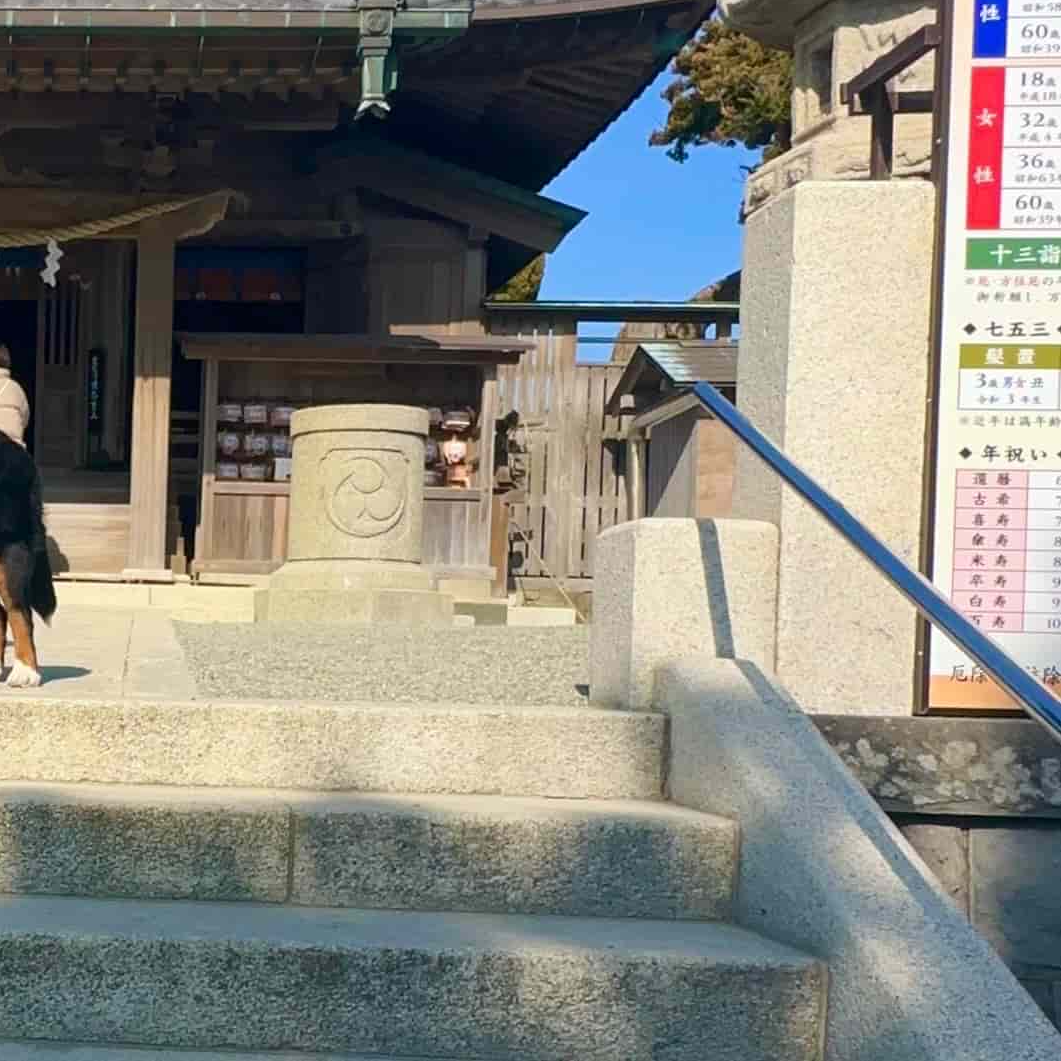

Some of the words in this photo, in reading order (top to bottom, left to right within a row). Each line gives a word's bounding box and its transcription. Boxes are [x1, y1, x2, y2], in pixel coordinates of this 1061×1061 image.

[973, 107, 997, 185] 女性
[985, 321, 1050, 337] 七五三
[981, 444, 1047, 463] 年祝い
